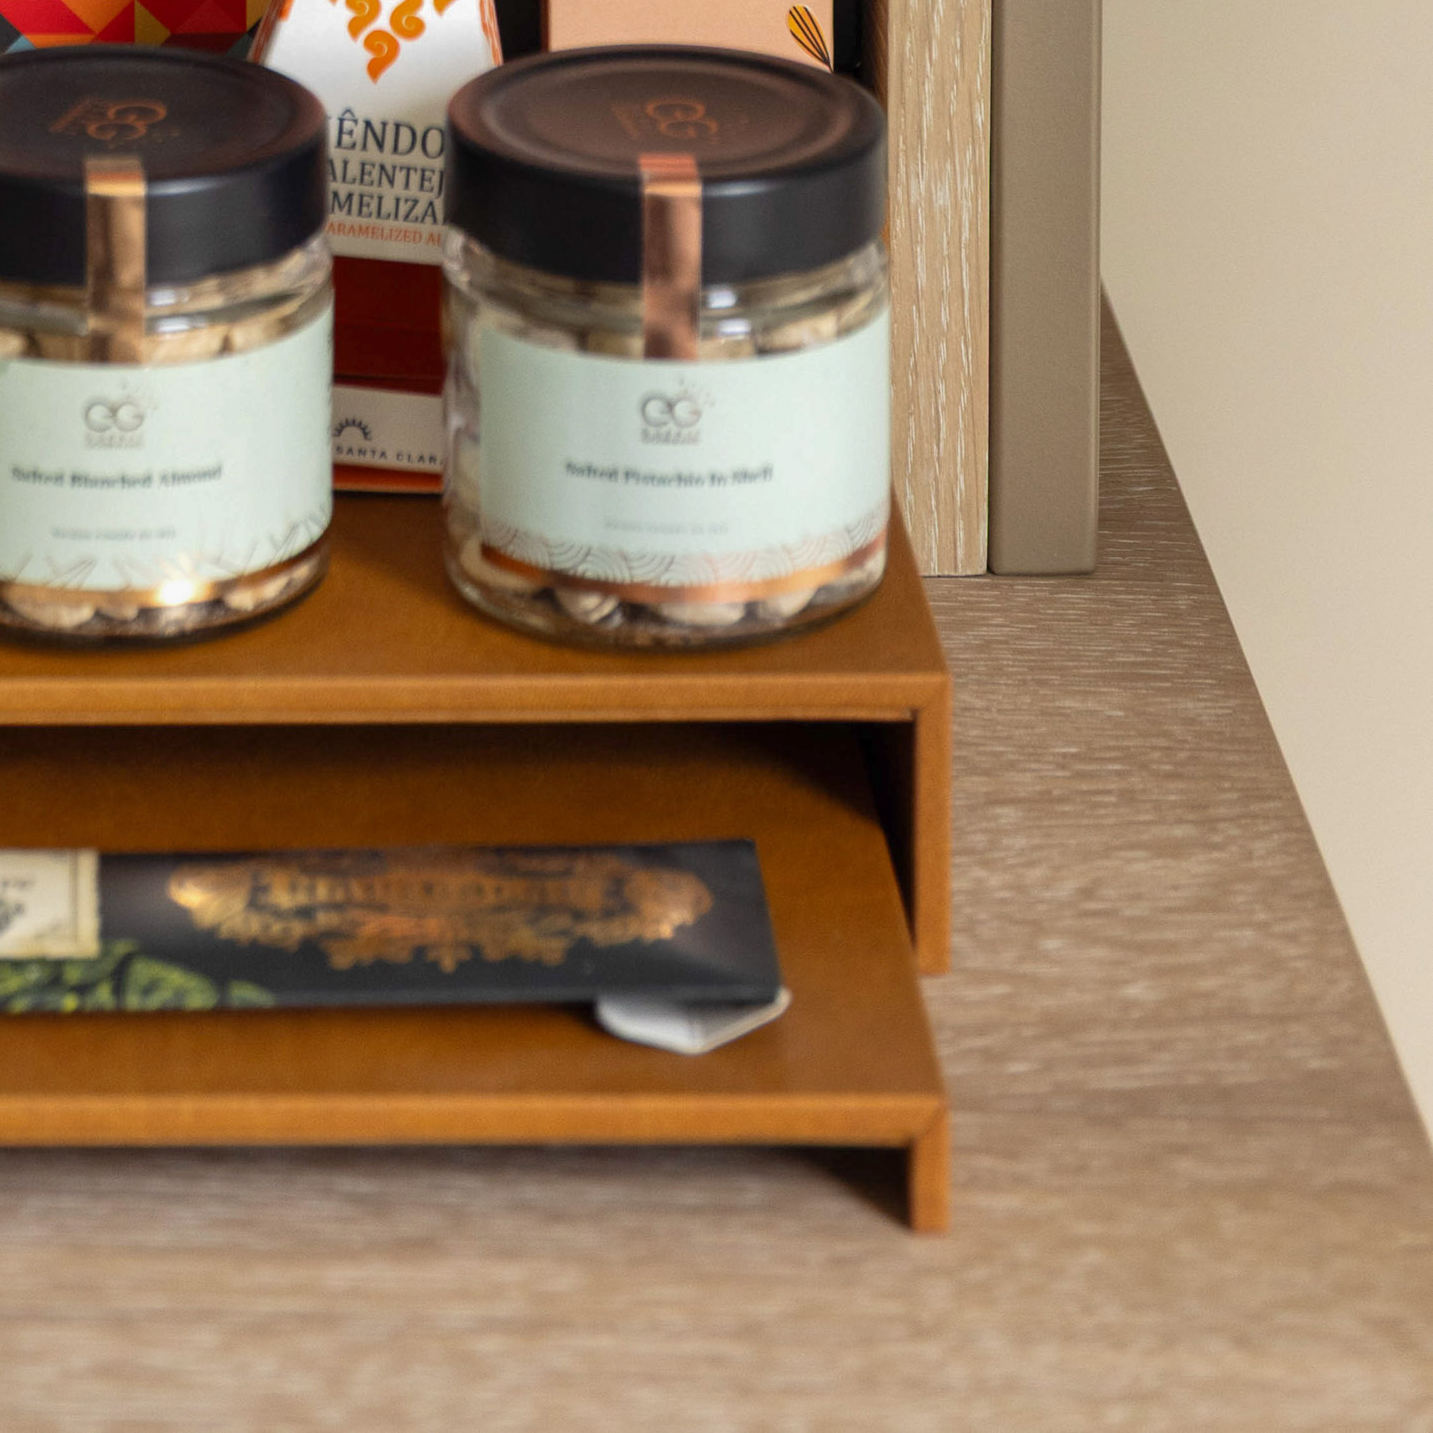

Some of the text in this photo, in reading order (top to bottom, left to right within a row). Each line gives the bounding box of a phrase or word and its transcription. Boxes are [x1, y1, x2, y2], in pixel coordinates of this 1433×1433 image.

[329, 108, 445, 159] ÊNDO
[329, 158, 445, 199] ALENTEJ
[330, 191, 445, 225] MELIZA
[327, 221, 422, 244] ARAMELIZED
[335, 446, 387, 459] SANTA
